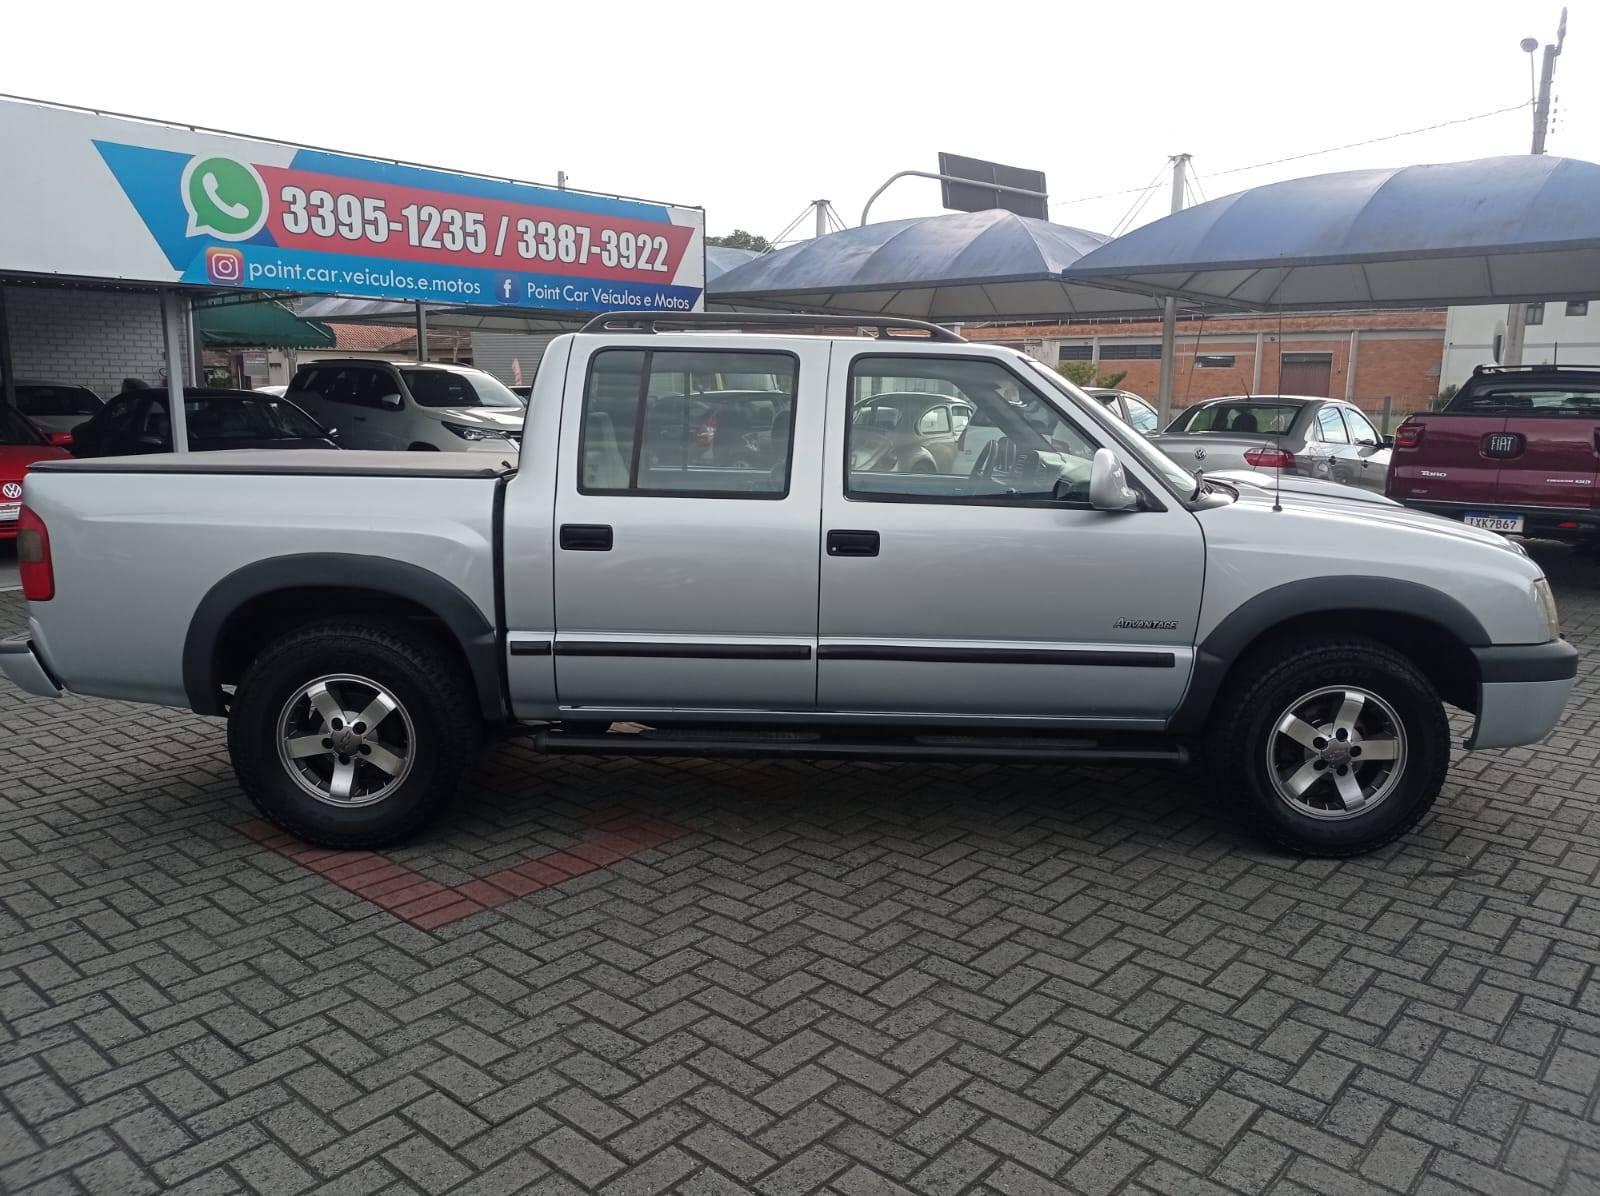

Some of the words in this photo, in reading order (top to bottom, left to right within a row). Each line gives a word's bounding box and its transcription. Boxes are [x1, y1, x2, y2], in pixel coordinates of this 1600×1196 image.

[281, 186, 487, 254] 3395-1235
[494, 216, 509, 256] /
[517, 218, 668, 272] 3387-3922
[249, 260, 481, 294] point.car.veiculos.e.motos
[527, 282, 560, 300] Point
[563, 285, 589, 302] Car
[592, 288, 641, 306] Veículos
[644, 295, 652, 306] e
[655, 294, 690, 310] Motos
[1491, 436, 1514, 451] FIAT
